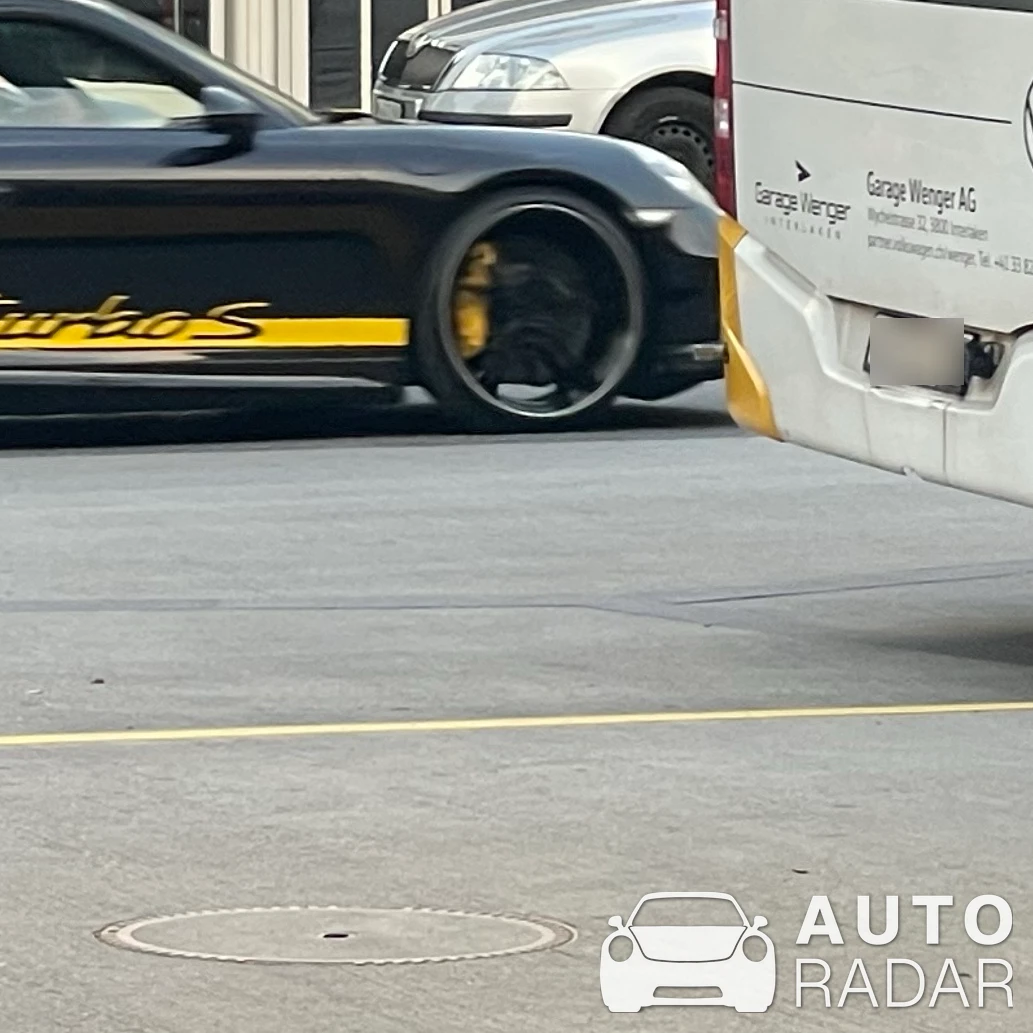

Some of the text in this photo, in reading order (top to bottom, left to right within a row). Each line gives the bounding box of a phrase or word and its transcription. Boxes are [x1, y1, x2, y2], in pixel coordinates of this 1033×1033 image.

[755, 181, 798, 215] Garage
[800, 190, 851, 225] Wenger
[867, 171, 977, 215] Garage Wenger AG
